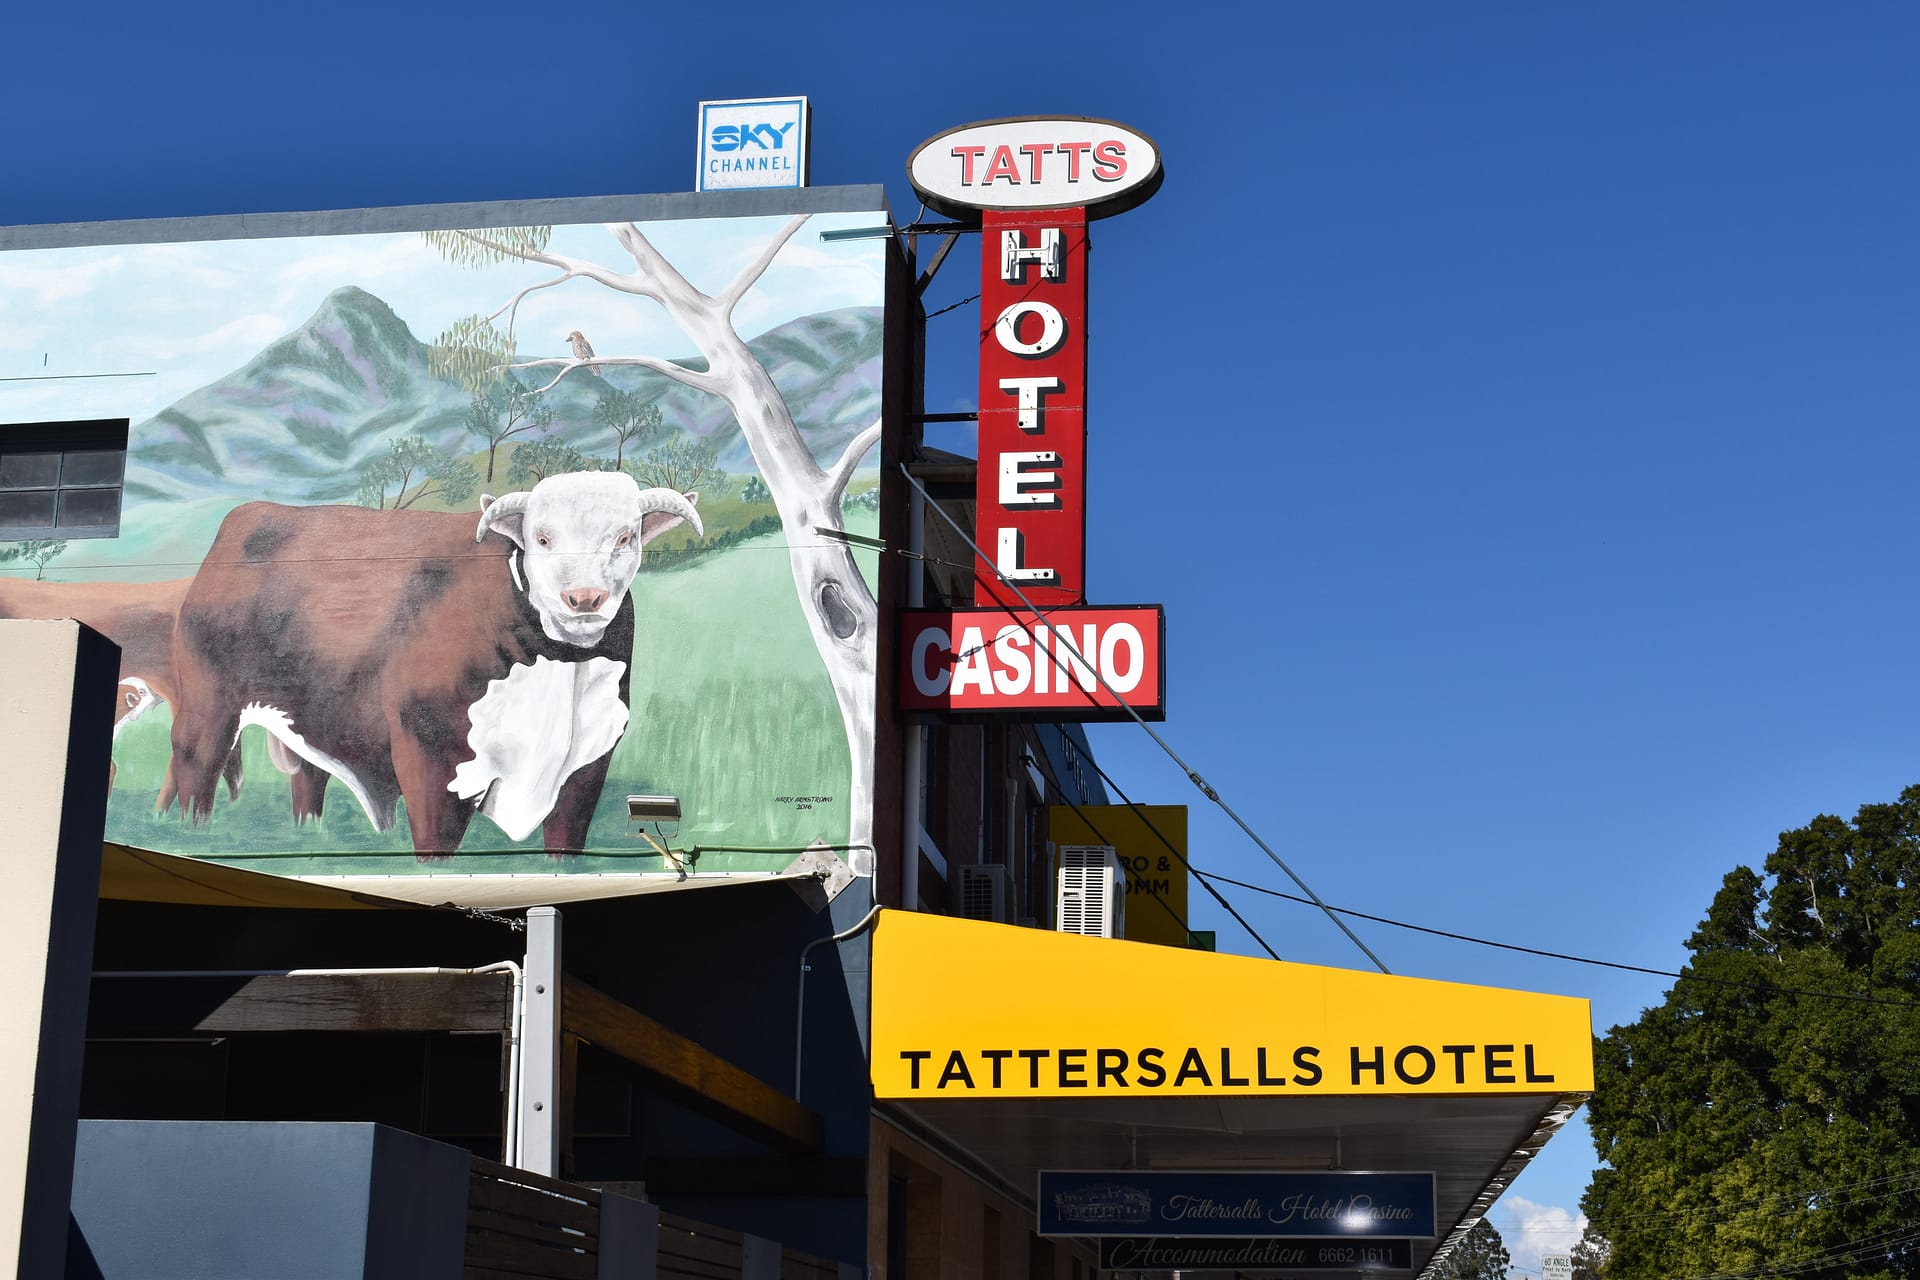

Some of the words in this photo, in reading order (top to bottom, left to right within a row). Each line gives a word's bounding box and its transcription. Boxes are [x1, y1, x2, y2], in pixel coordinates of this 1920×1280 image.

[711, 122, 795, 152] SKY
[710, 156, 791, 173] CHANNEL
[950, 140, 1129, 186] TATTS
[995, 228, 1067, 584] HOTEL
[911, 622, 1145, 697] CASINO
[1157, 856, 1170, 871] &
[900, 1046, 1322, 1089] TATTERSALLS
[1350, 1044, 1555, 1085] HOTEL
[1160, 1194, 1263, 1220] Tattersalls
[1268, 1193, 1344, 1223] Hotel
[1347, 1194, 1412, 1221] Casino
[1109, 1238, 1306, 1269] Accommodation
[1318, 1247, 1355, 1263] 6662
[1360, 1247, 1393, 1263] 1611
